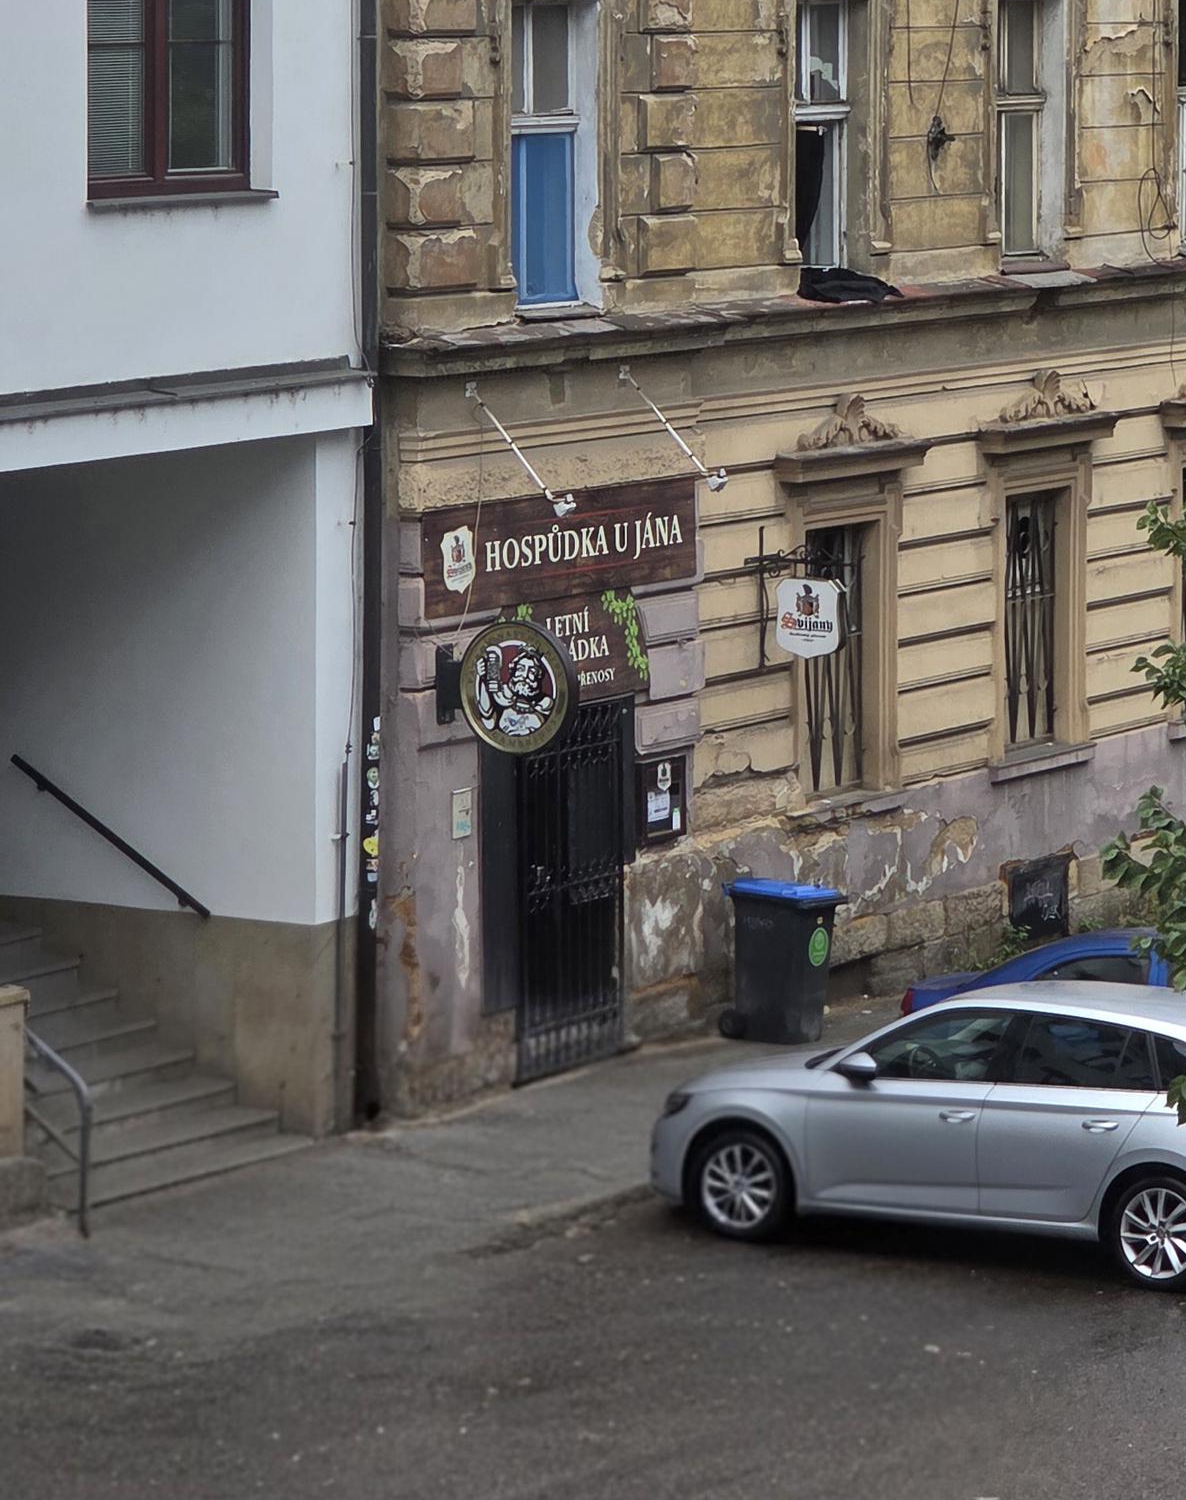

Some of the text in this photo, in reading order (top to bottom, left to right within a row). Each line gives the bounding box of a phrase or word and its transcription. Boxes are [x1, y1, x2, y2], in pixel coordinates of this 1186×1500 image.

[485, 512, 683, 572] HOSPŮDKA U JÁNA
[781, 611, 833, 633] Svijany
